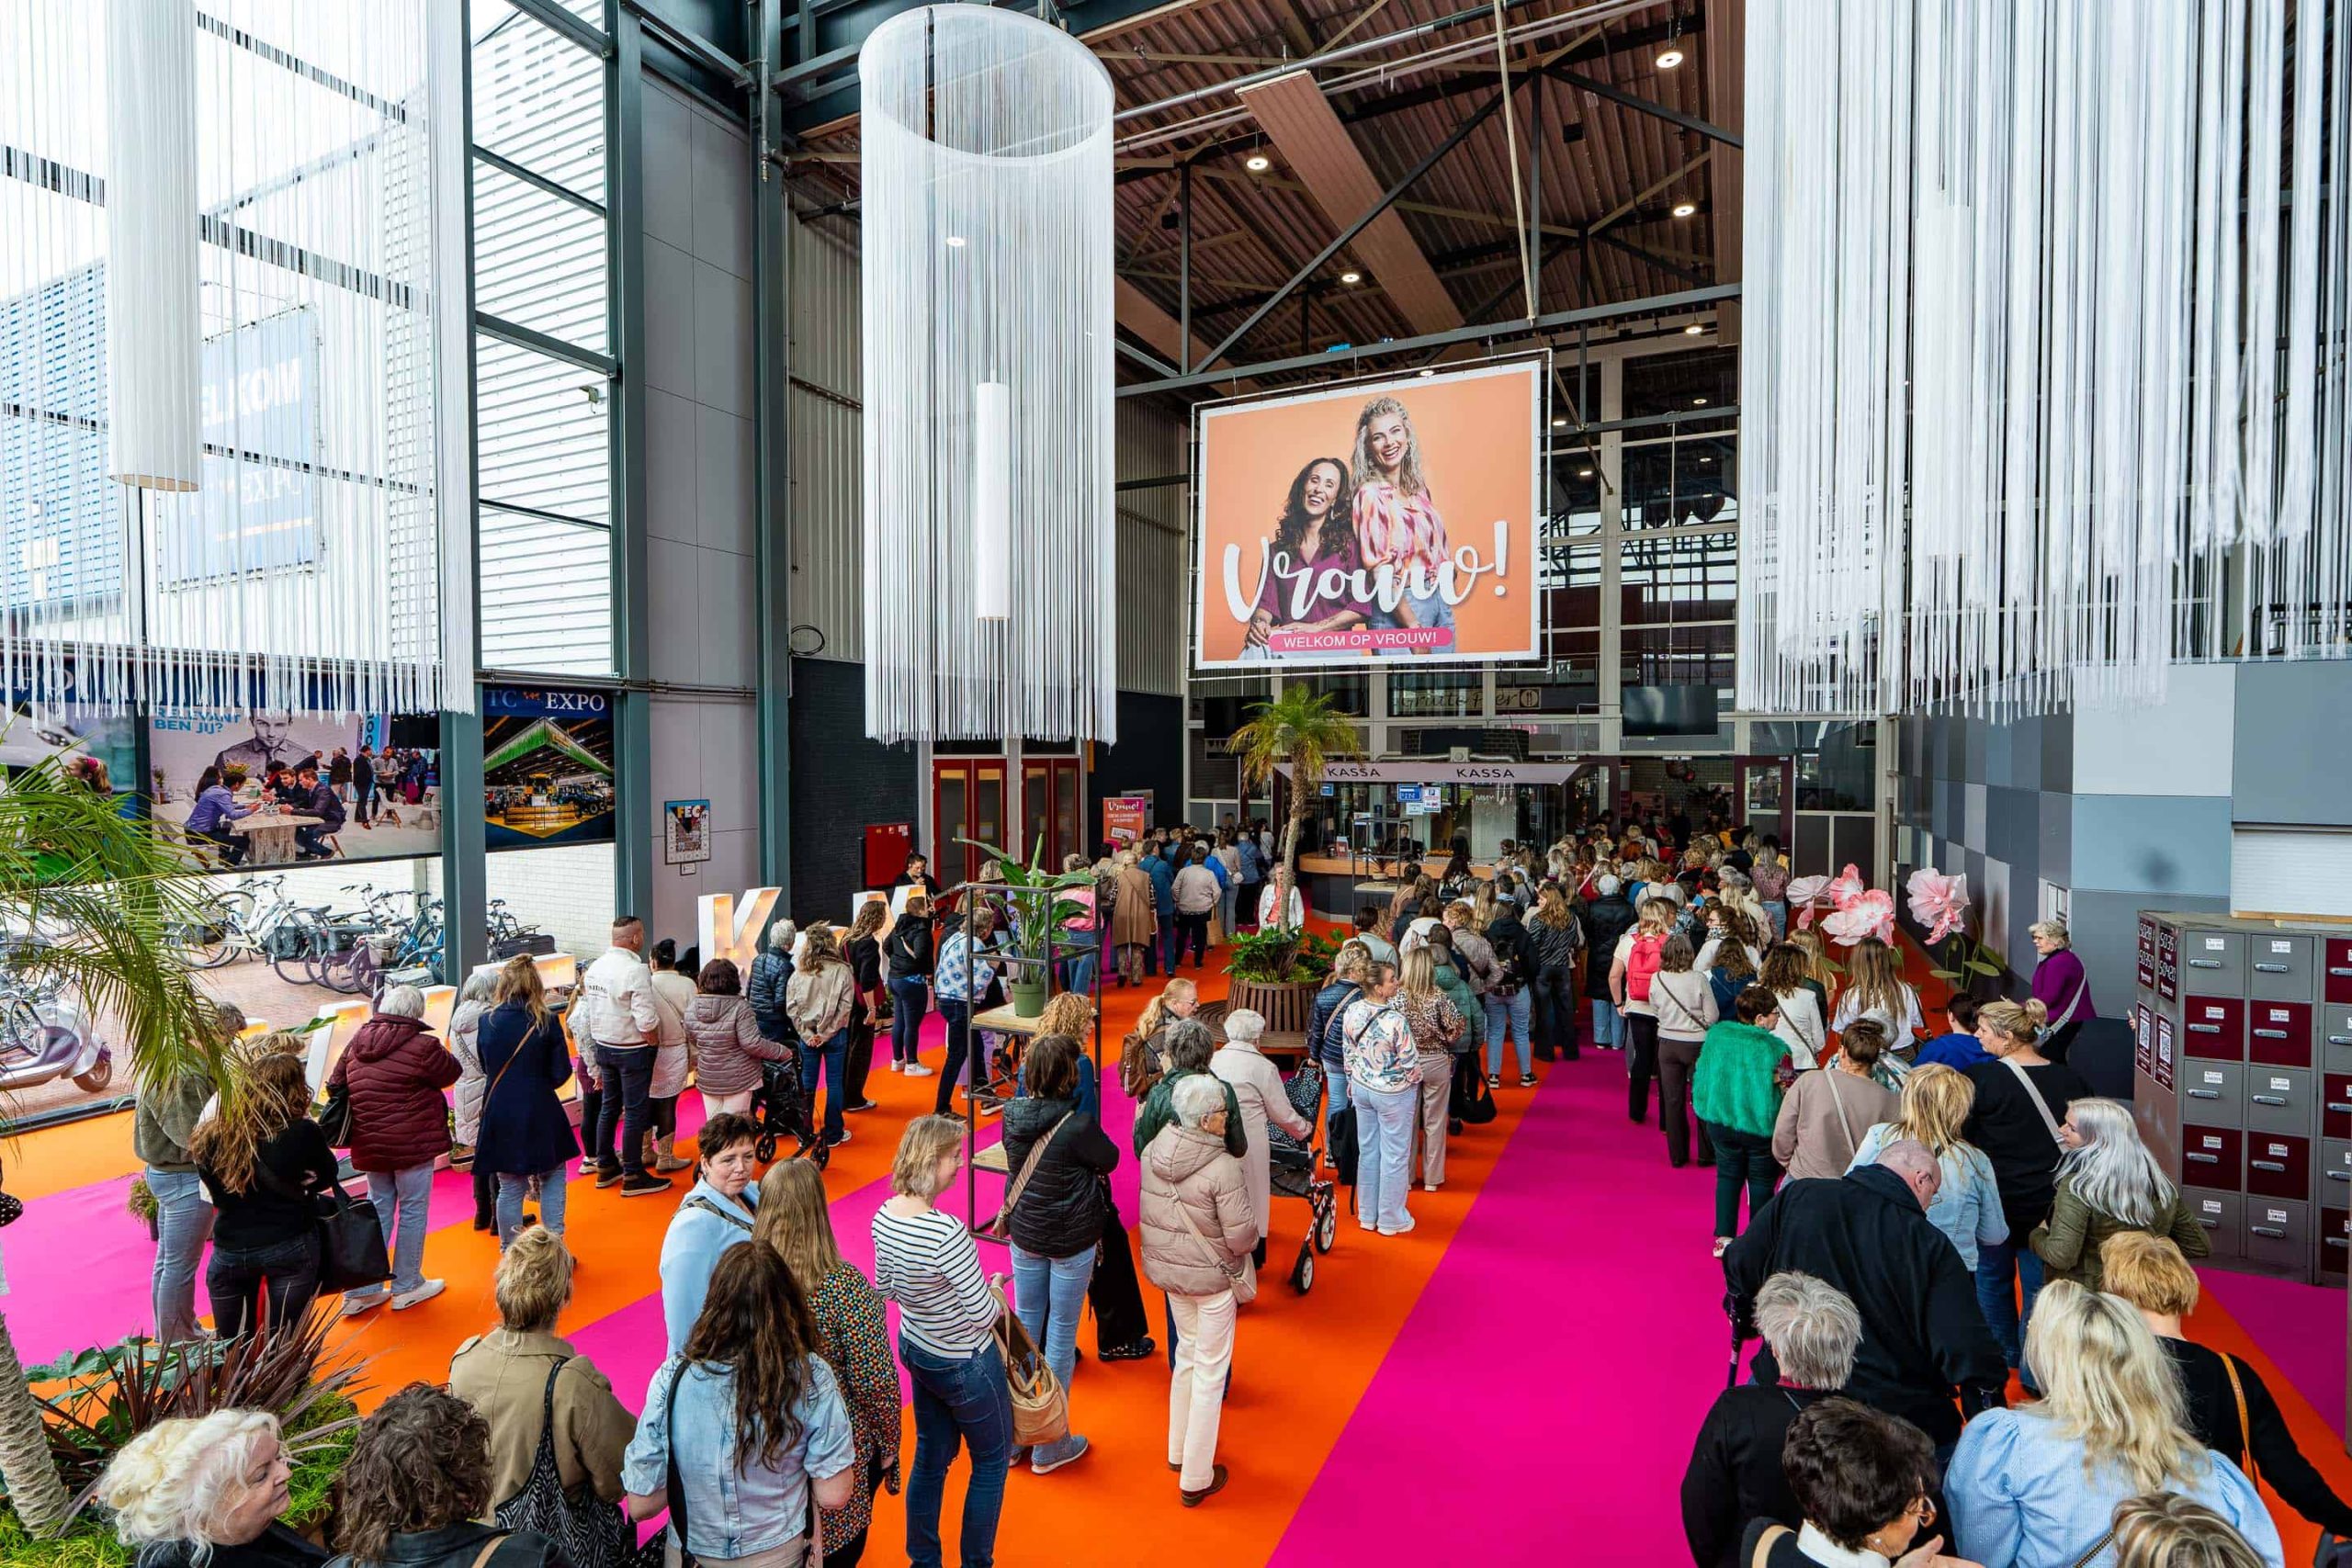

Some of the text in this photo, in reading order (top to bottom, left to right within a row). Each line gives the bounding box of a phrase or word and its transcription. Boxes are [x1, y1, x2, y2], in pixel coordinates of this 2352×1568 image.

[1223, 521, 1509, 623] Vrouw!
[1283, 632, 1437, 649] WELKOM OP VROUW!
[545, 692, 605, 712] EXPO
[154, 719, 191, 731] BEN
[1327, 767, 1515, 778] KASSA KASSA
